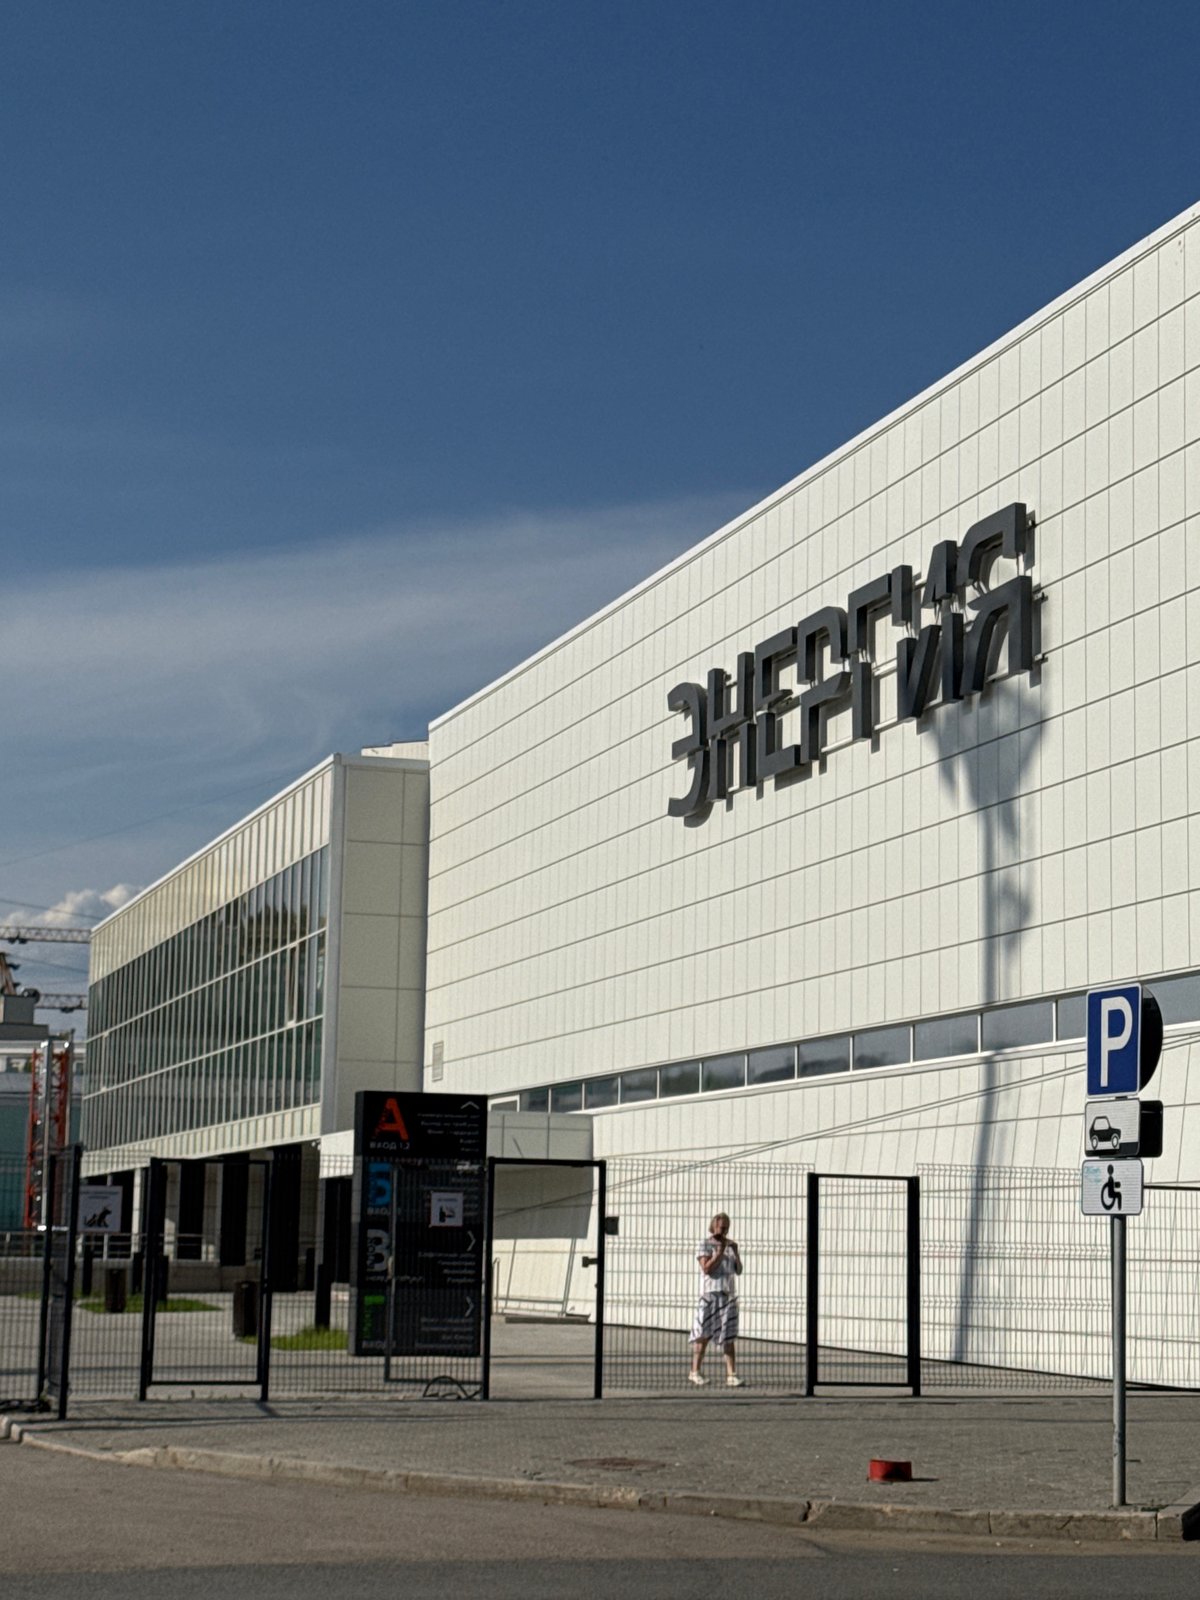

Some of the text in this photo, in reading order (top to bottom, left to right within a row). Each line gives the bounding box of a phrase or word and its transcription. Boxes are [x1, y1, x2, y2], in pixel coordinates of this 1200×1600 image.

[667, 502, 1032, 817] ЭНЕРГИЯ
[1100, 996, 1133, 1087] P
[370, 1097, 410, 1141] А
